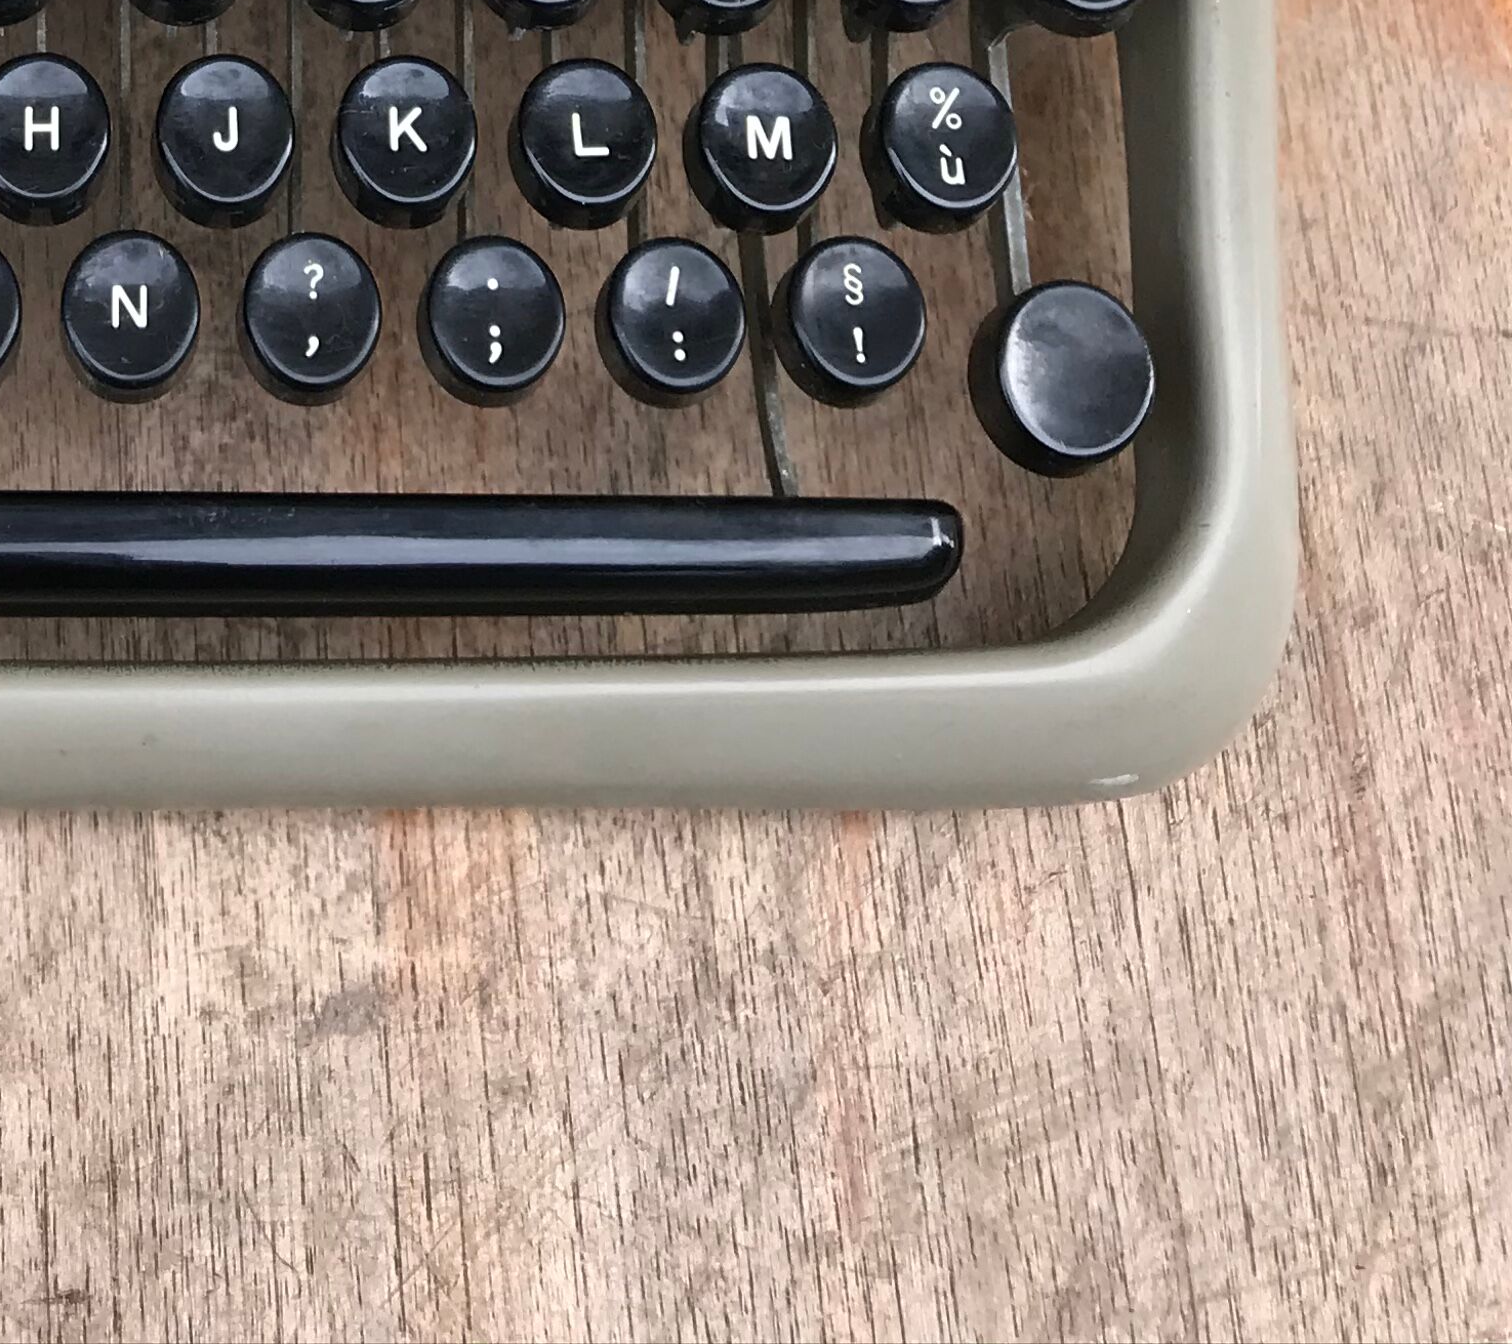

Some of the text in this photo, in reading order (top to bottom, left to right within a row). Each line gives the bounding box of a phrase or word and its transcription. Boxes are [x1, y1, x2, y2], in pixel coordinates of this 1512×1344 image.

[24, 105, 60, 151] H
[212, 106, 239, 152] J
[388, 105, 428, 152] K
[928, 86, 962, 130] %
[571, 112, 610, 157] L
[745, 114, 793, 160] M
[939, 143, 966, 185] ù
[303, 259, 324, 300] ?
[111, 284, 148, 328] N
[852, 326, 866, 364] !
